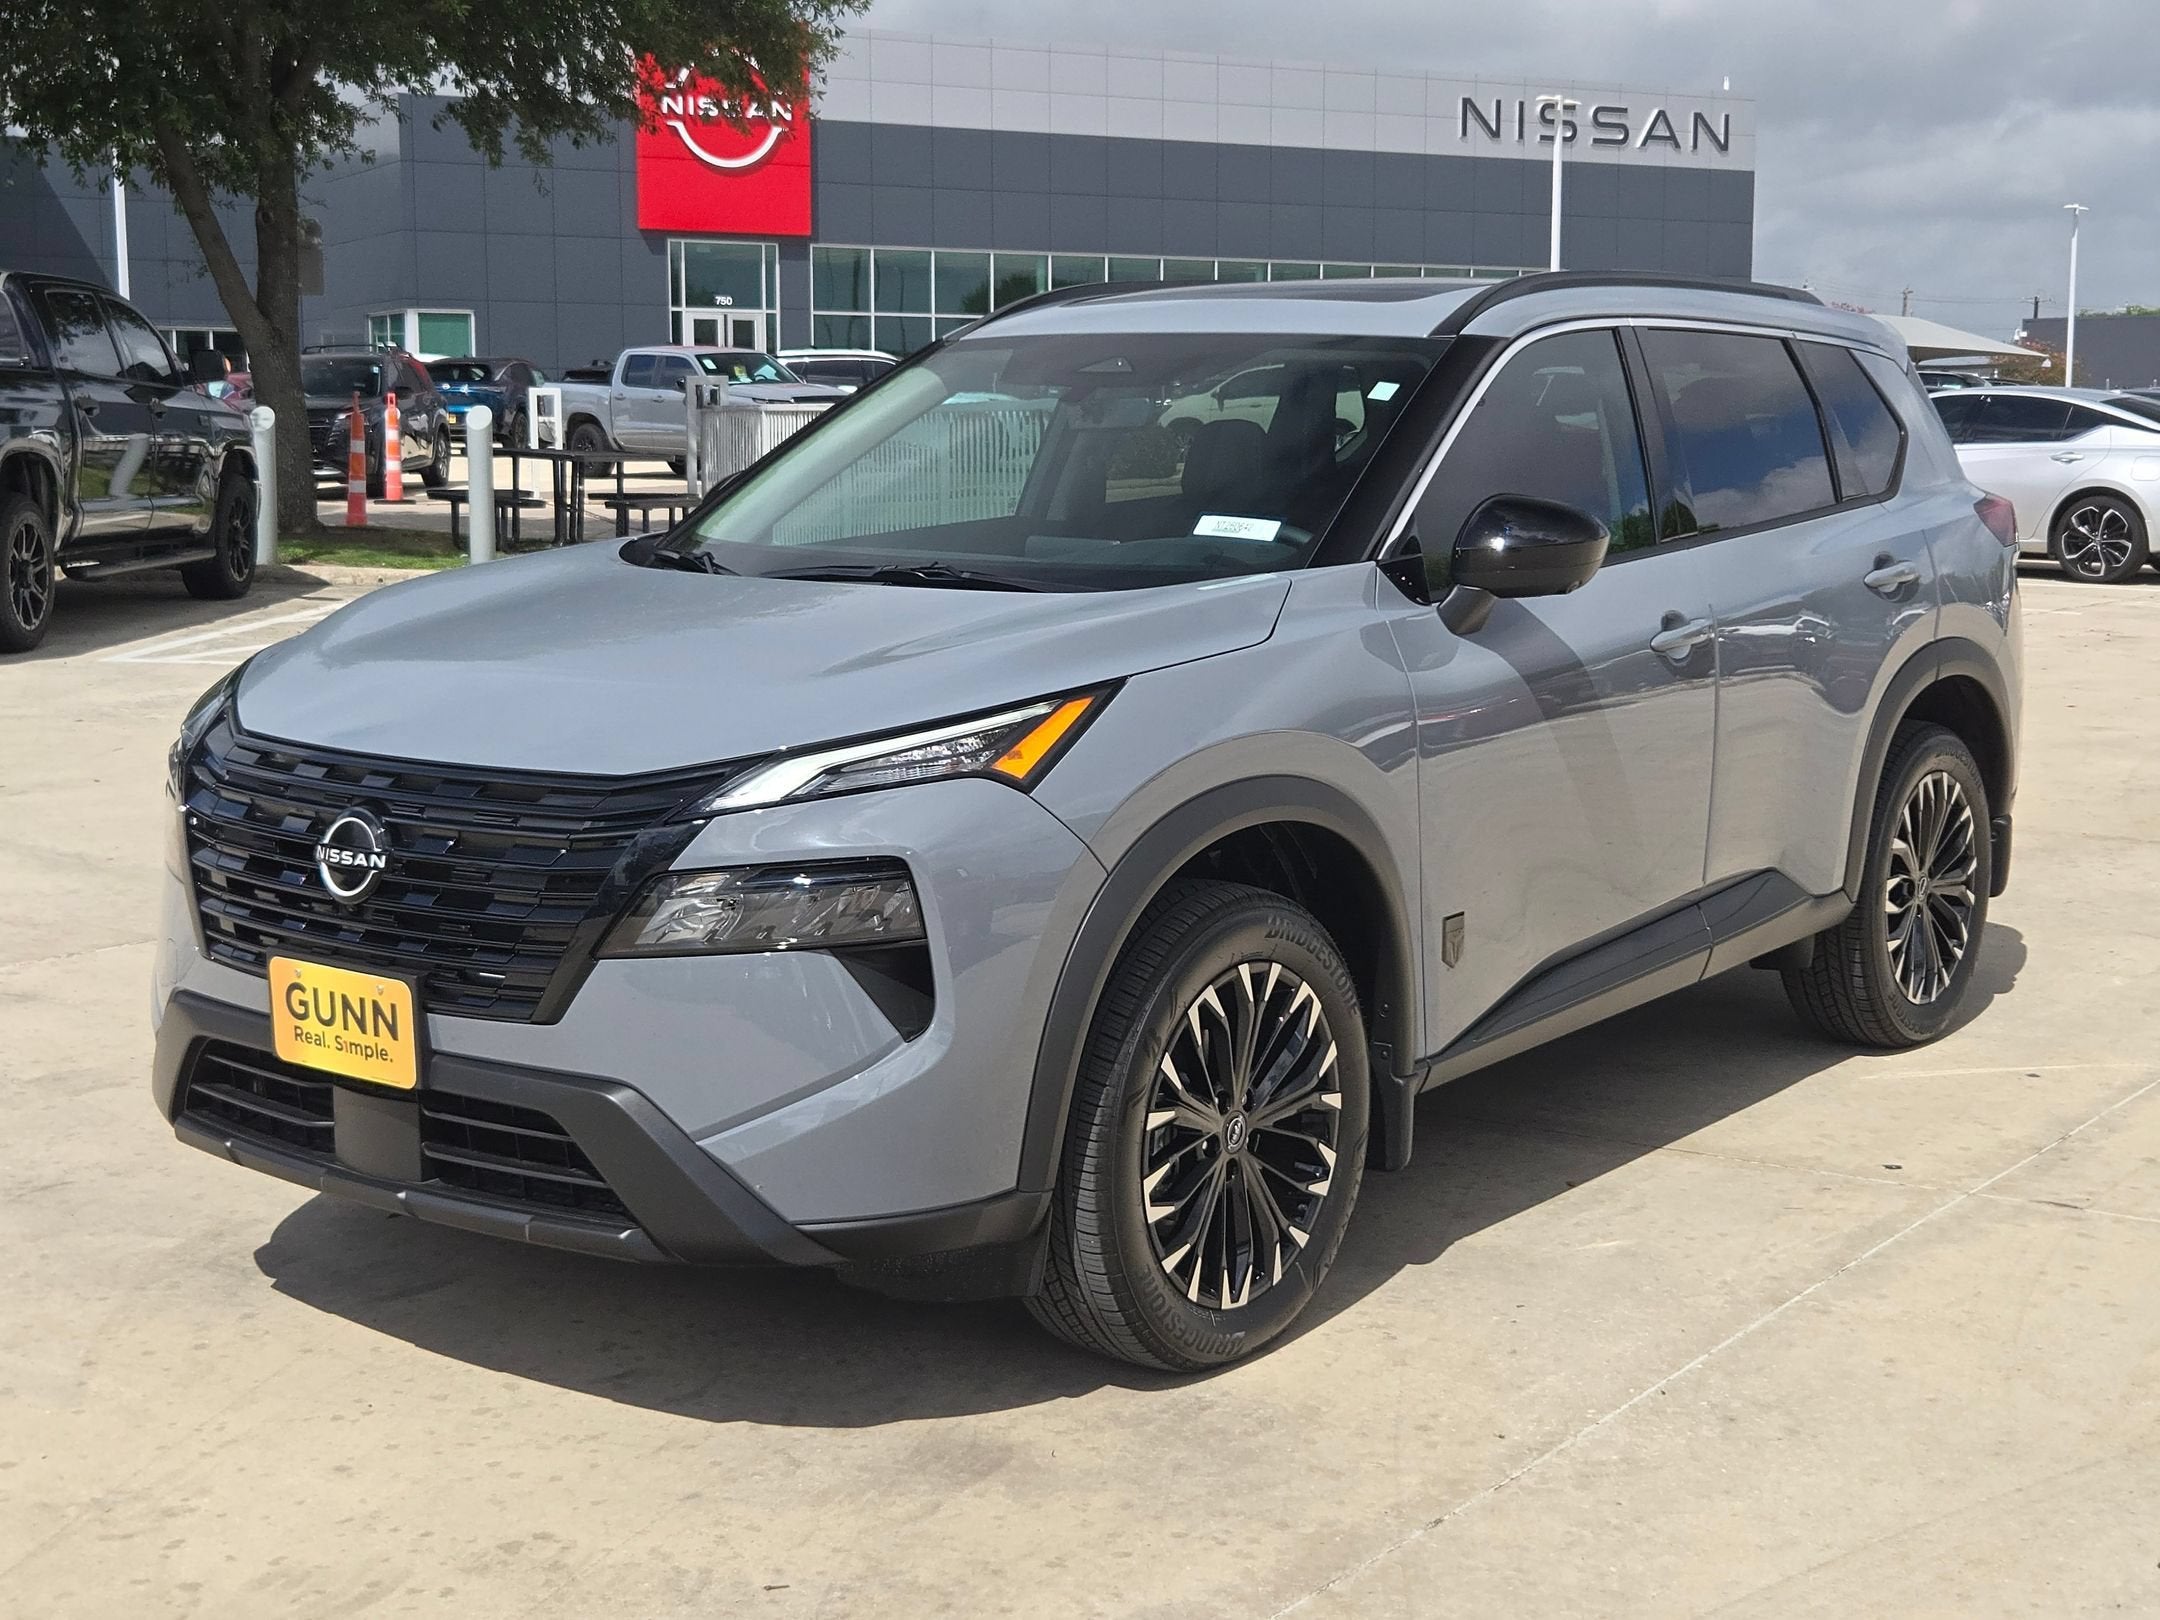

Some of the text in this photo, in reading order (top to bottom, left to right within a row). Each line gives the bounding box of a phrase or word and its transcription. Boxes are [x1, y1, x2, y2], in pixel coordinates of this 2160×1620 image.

[1460, 96, 1730, 153] NISSAN
[715, 296, 733, 306] 750
[316, 847, 387, 869] NISSAN
[1265, 915, 1359, 1016] BRIDGESTONE
[285, 981, 399, 1042] GUNN
[294, 1024, 330, 1049] Real.
